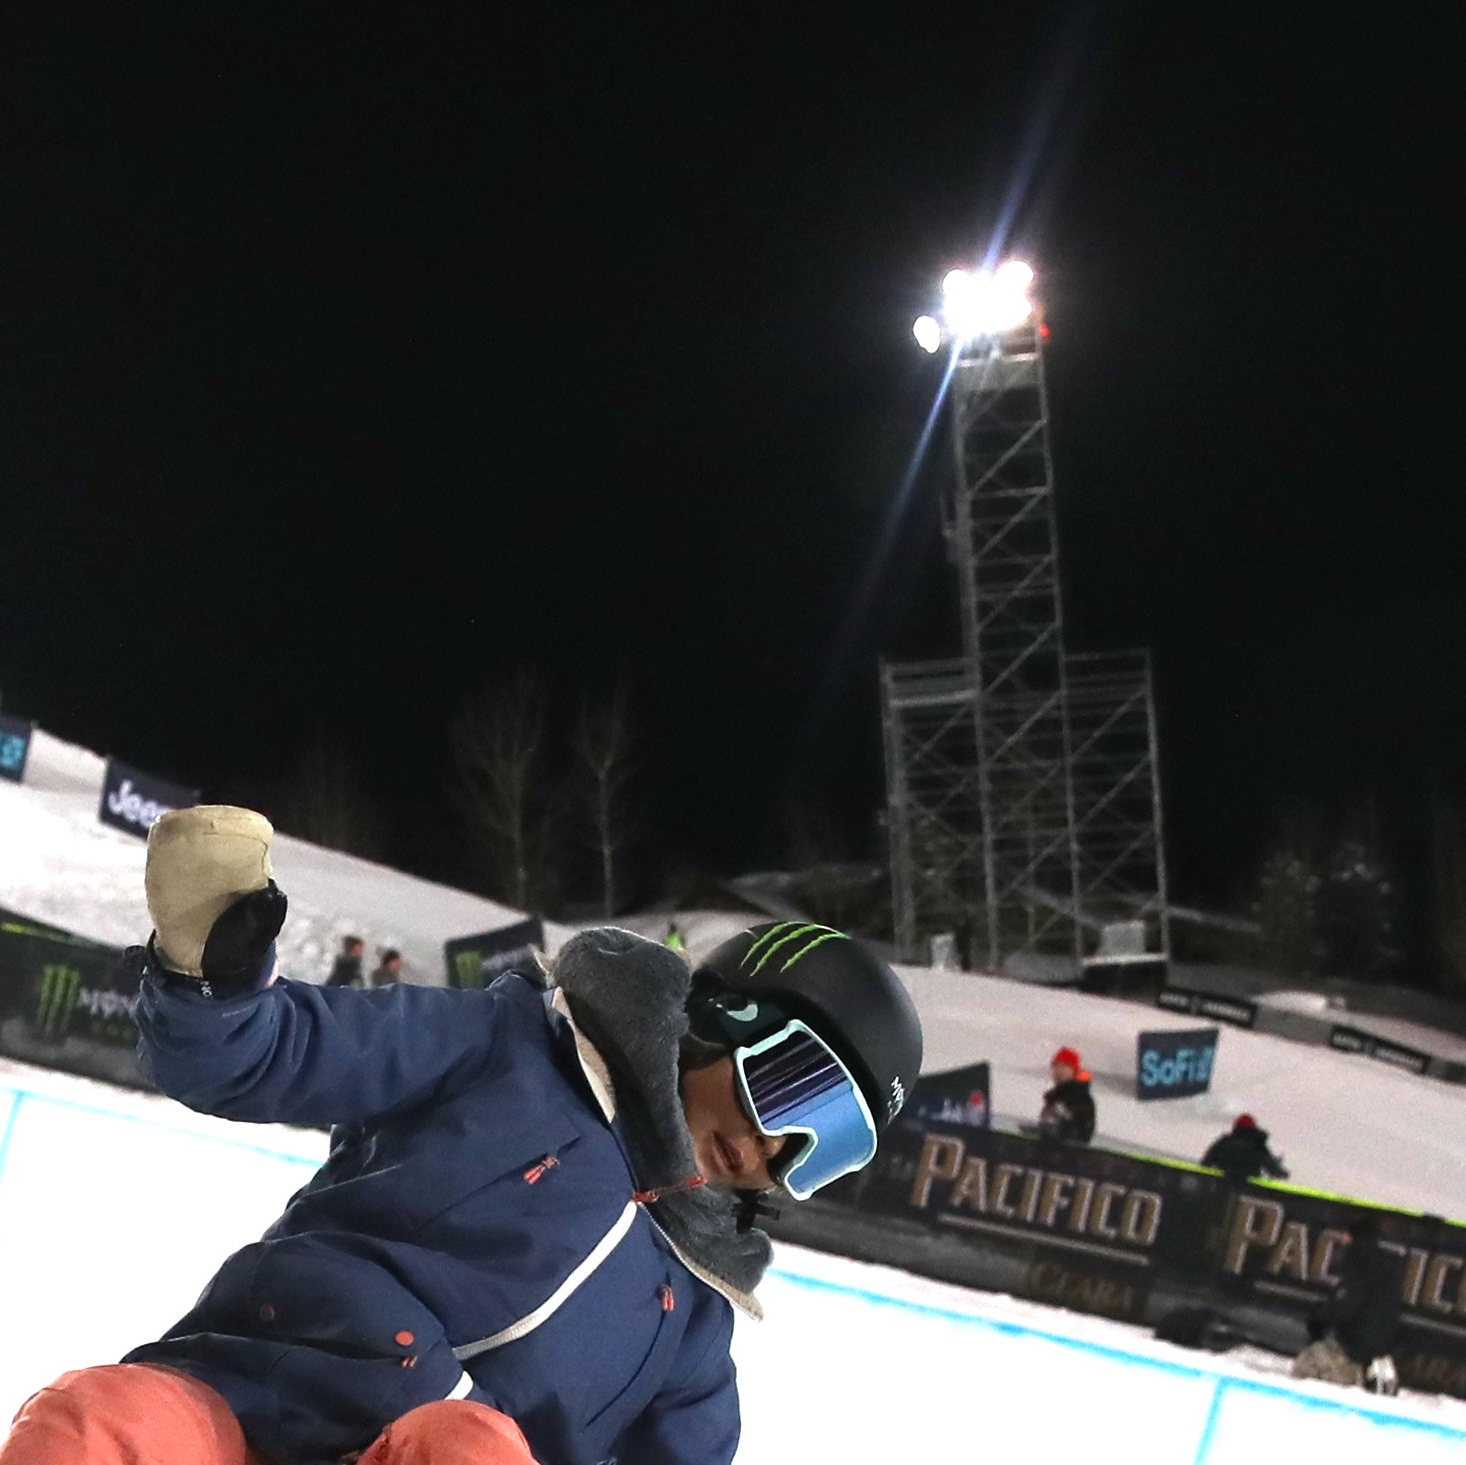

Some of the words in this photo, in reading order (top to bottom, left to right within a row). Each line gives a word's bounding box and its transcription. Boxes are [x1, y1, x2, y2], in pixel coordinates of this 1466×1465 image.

[108, 780, 168, 829] Jee
[1141, 1049, 1198, 1088] SoFi
[911, 1132, 1164, 1247] PACIFICO
